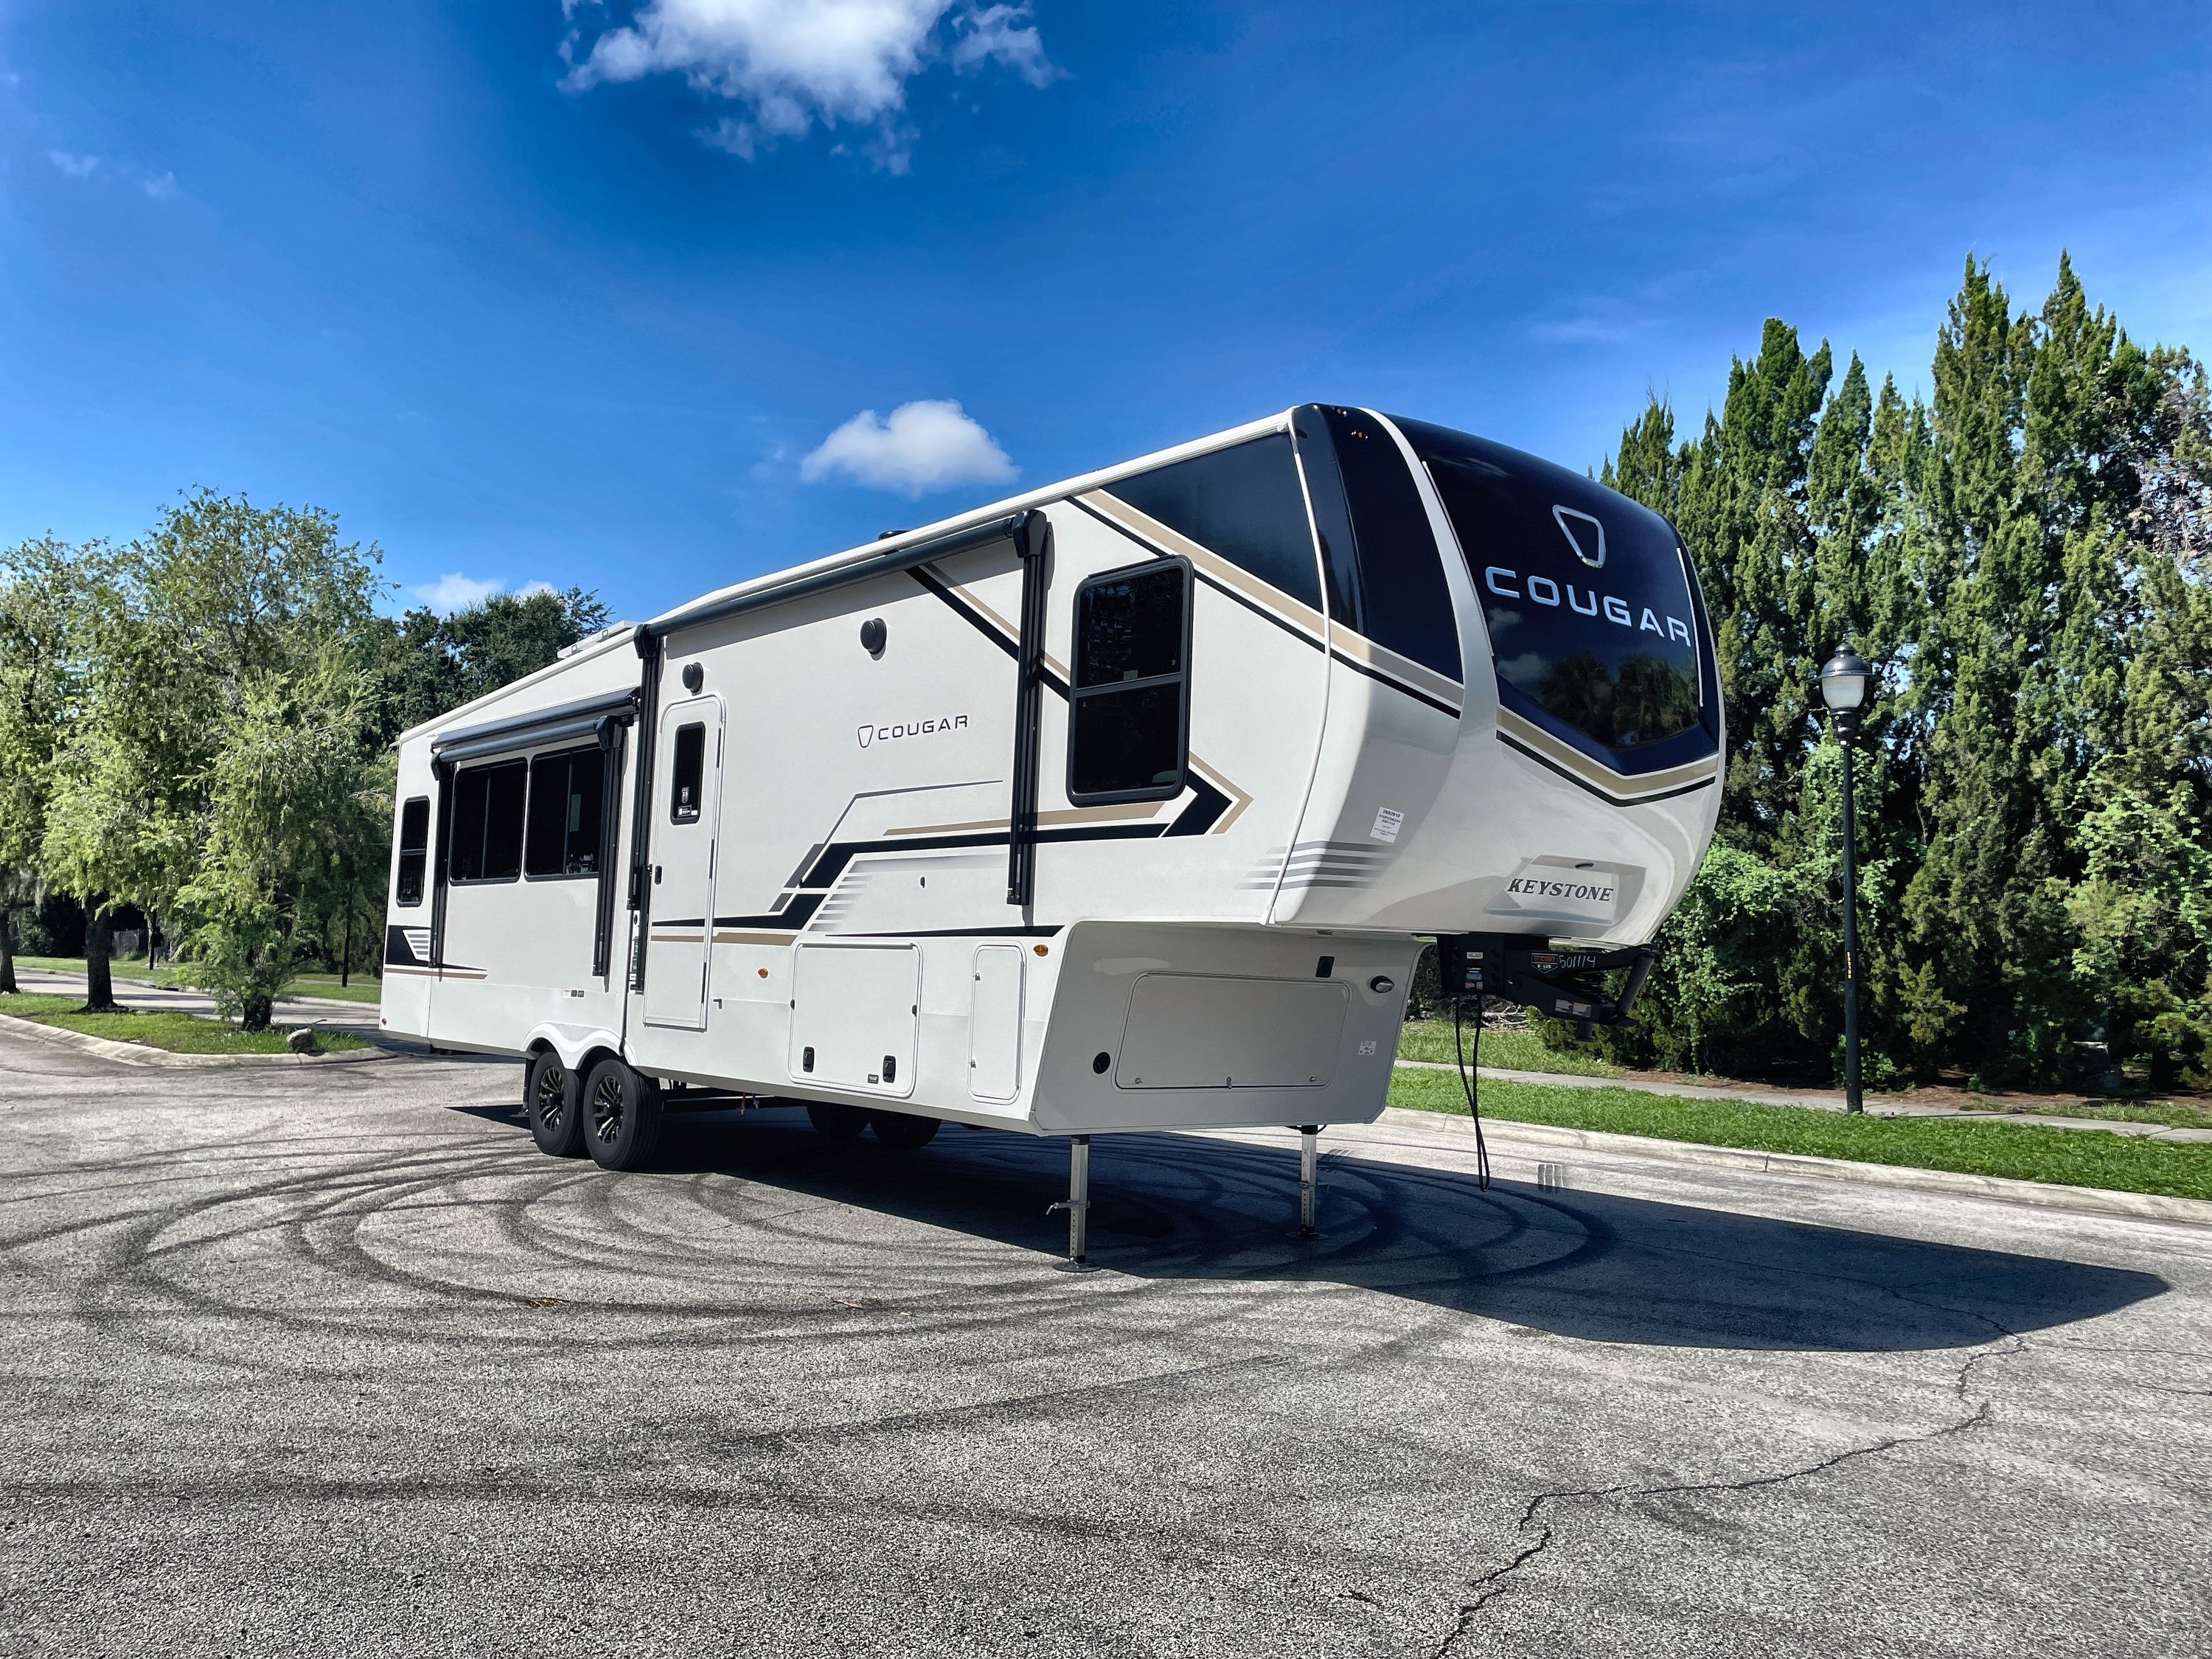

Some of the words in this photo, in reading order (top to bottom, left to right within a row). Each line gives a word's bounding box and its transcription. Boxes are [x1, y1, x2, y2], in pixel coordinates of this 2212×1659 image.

[1485, 566, 1691, 647] COUGAR
[878, 714, 968, 740] COUGAR
[1507, 878, 1614, 902] KEYSTONE
[1559, 955, 1596, 969] 501114
